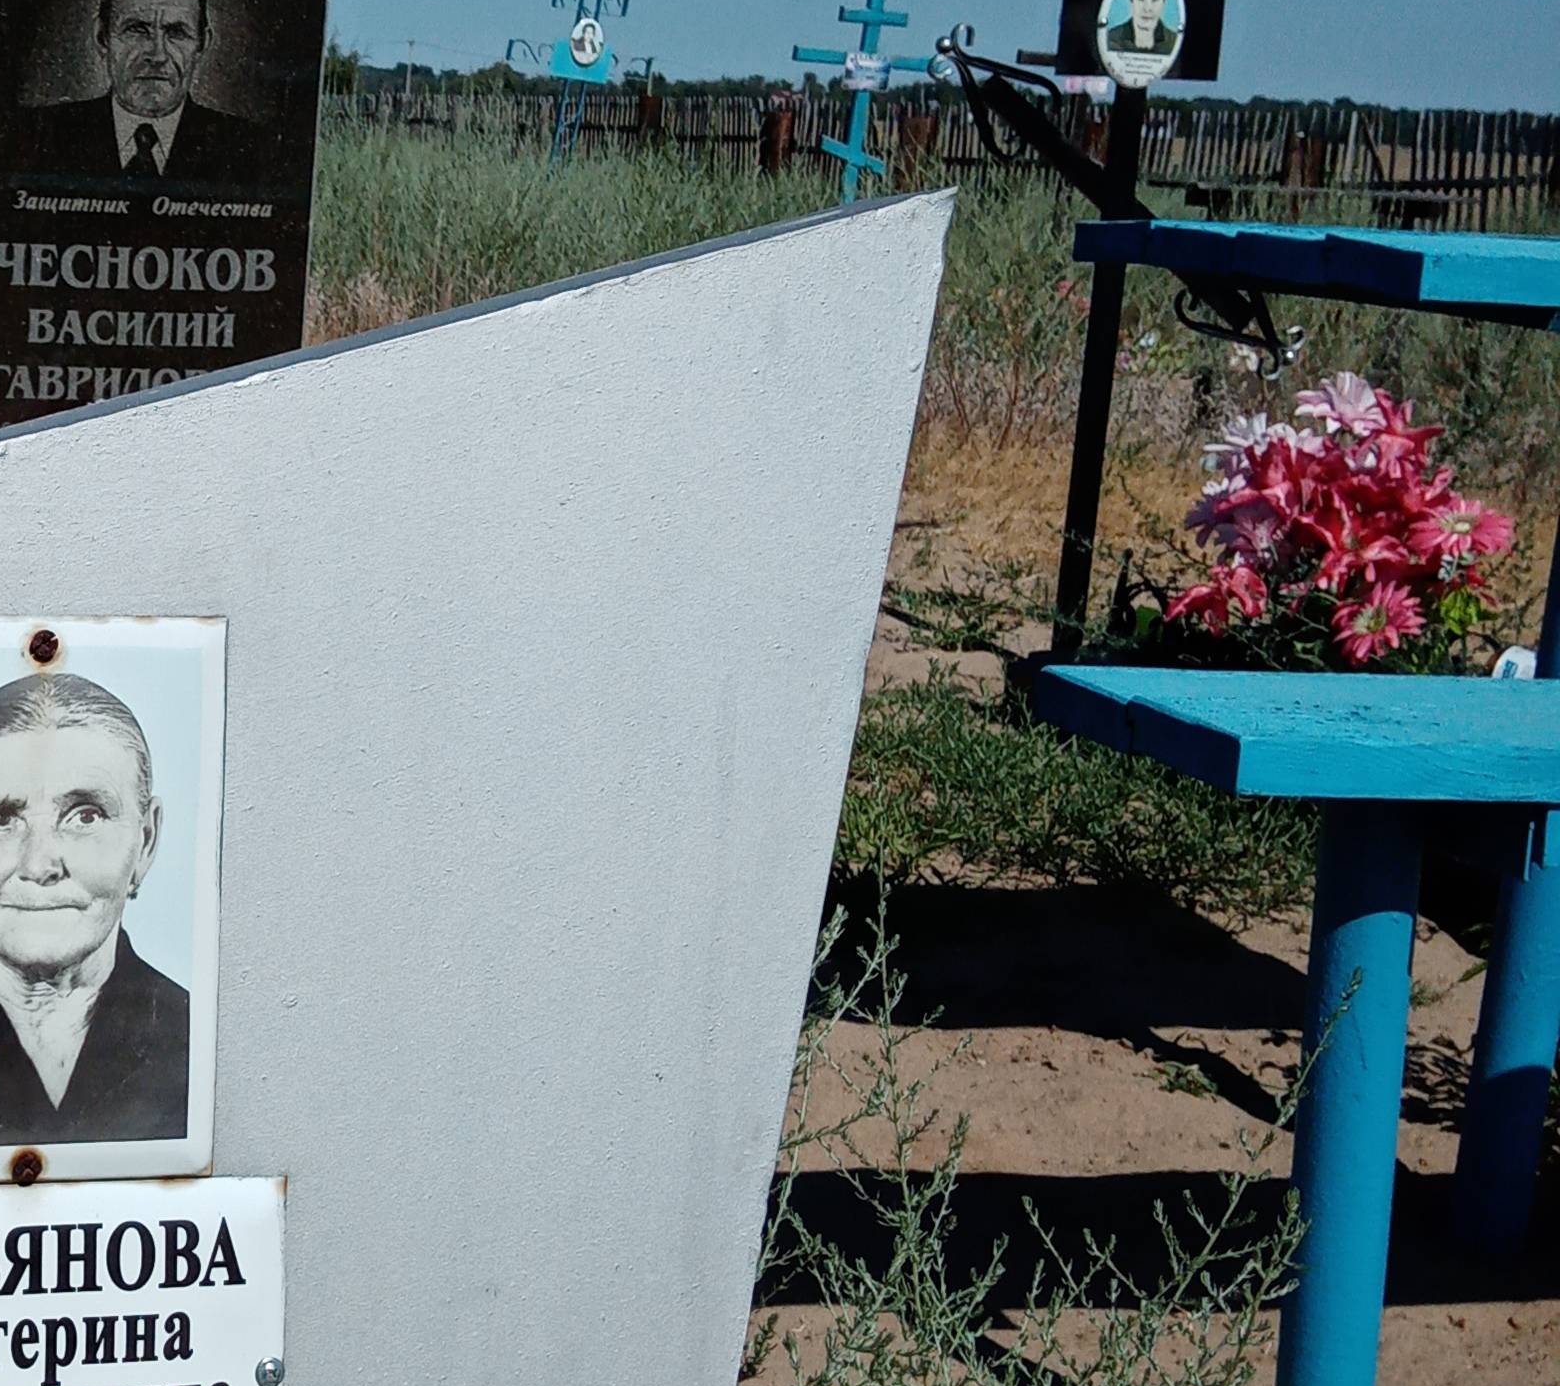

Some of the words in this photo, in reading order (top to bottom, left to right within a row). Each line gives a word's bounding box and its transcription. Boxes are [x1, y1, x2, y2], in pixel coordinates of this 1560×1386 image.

[12, 190, 130, 215] Защитник
[152, 196, 273, 218] Отечества
[27, 305, 236, 348] ВАСИЛИЙ
